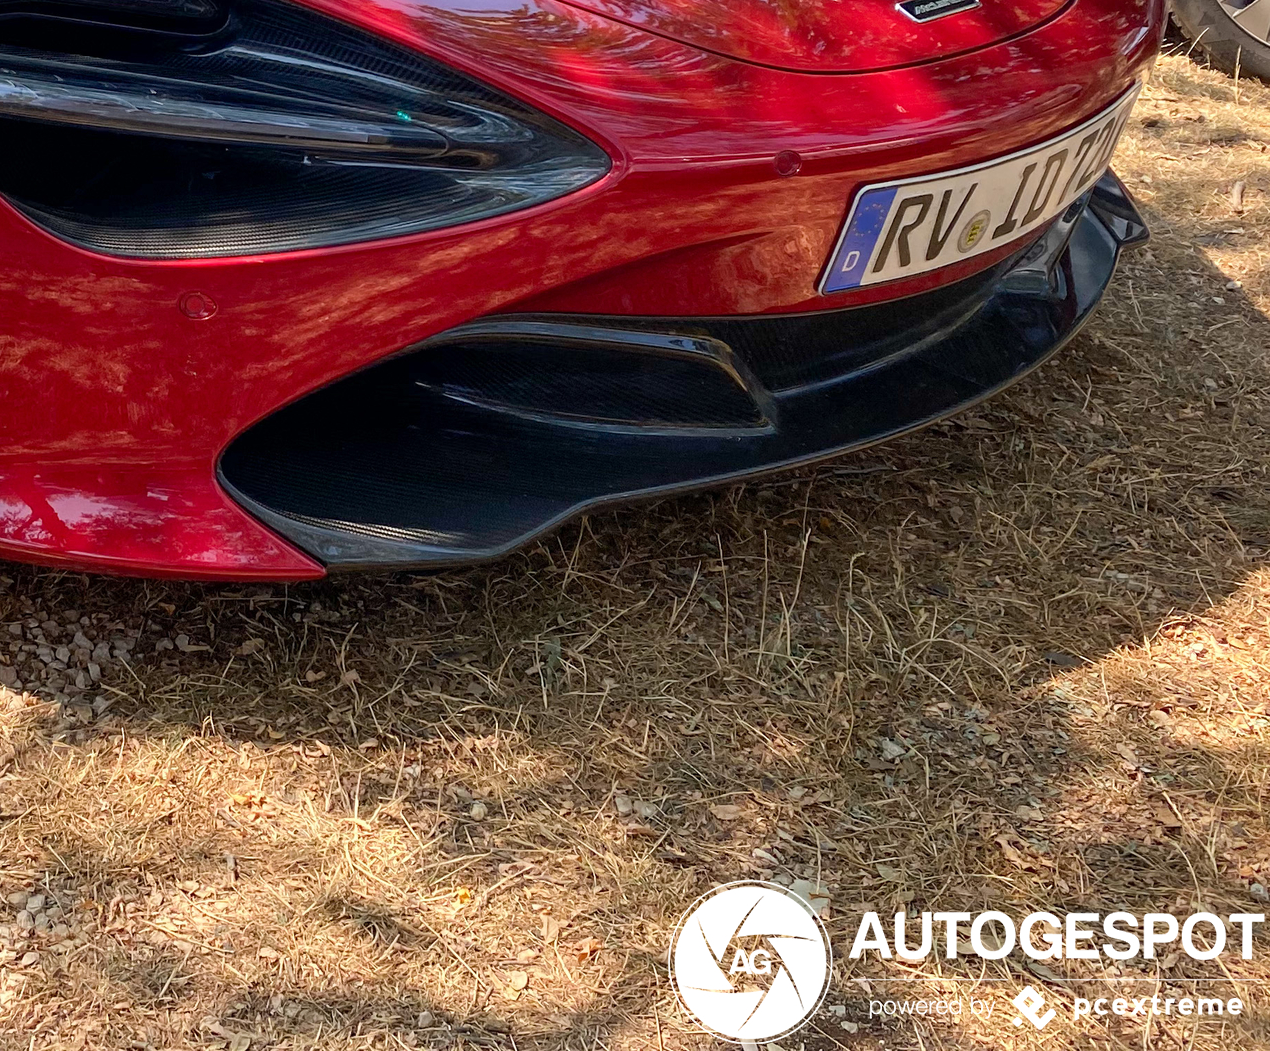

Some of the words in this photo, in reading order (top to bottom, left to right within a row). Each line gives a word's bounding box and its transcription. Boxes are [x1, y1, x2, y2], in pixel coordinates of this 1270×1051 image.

[872, 183, 979, 274] RV
[992, 148, 1069, 240] ID
[842, 251, 860, 272] D
